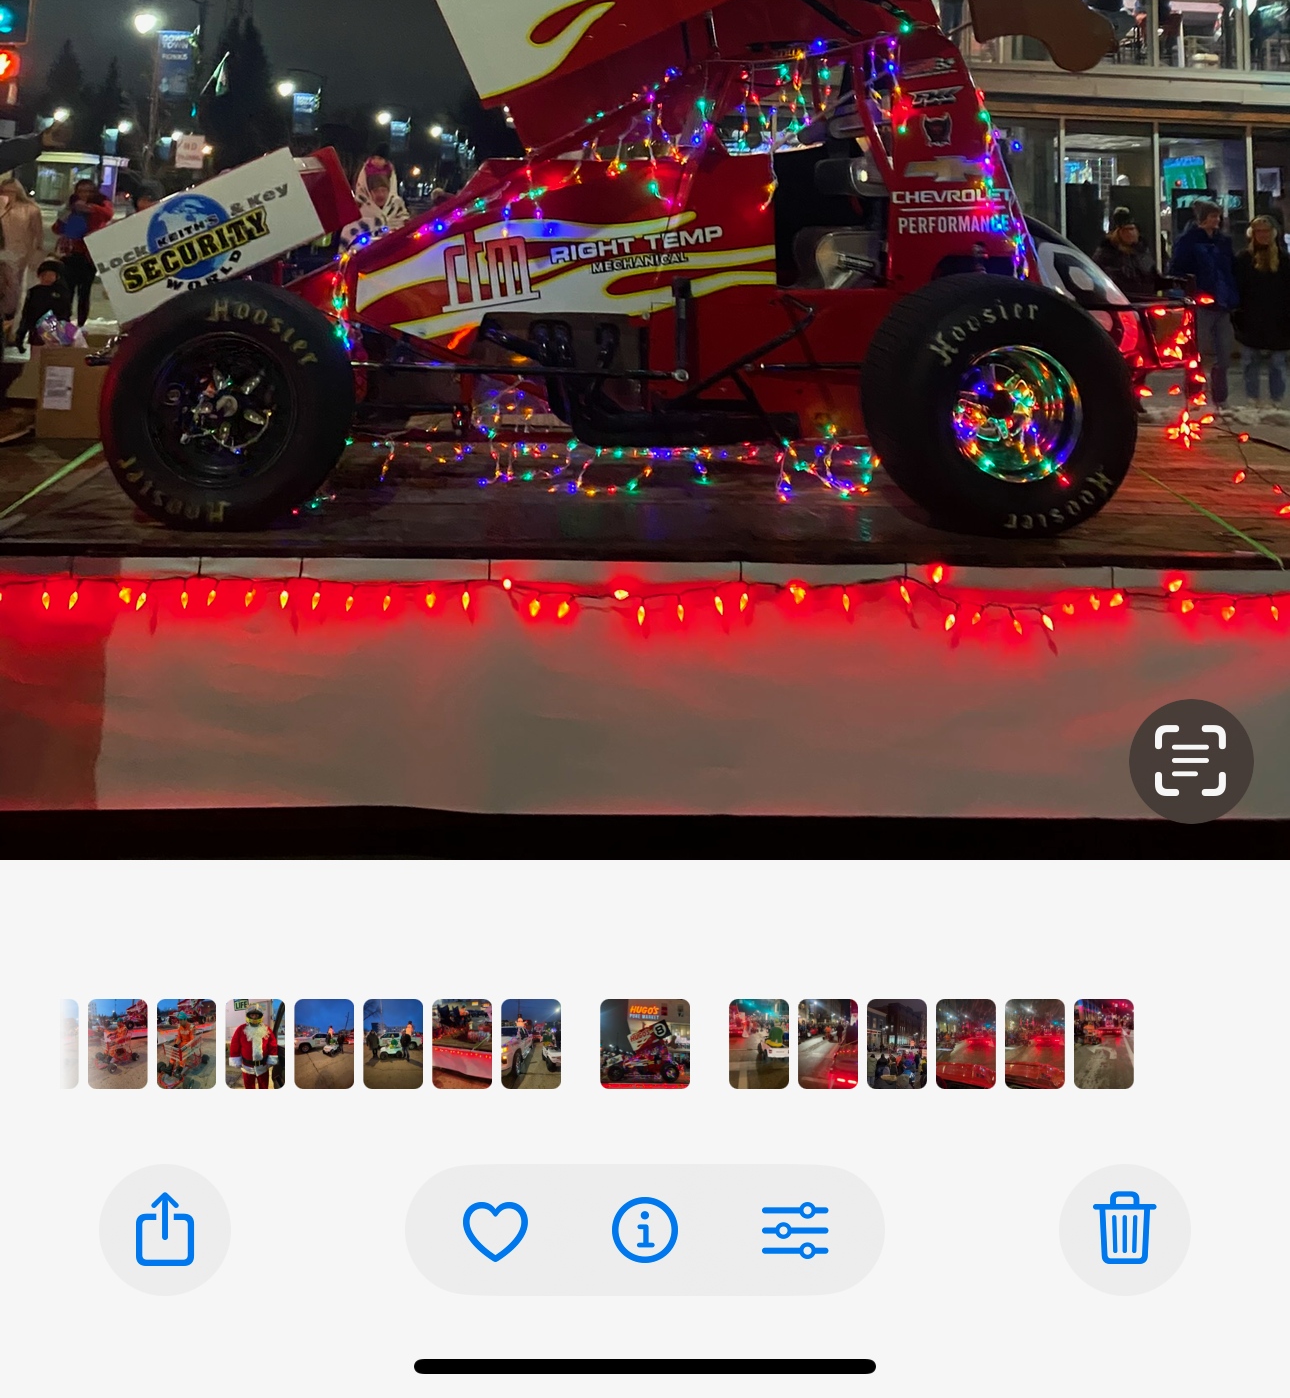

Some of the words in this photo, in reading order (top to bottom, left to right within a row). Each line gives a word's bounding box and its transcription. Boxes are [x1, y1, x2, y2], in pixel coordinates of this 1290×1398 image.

[230, 202, 246, 217] &
[892, 188, 1013, 204] CHEVROLET
[157, 214, 218, 247] KEITH'S
[898, 214, 1011, 234] PERFORMANCE
[121, 207, 269, 292] SECURITY
[550, 236, 635, 264] RIGHT
[644, 226, 723, 251] TEMP
[167, 250, 242, 290] WORLD
[592, 252, 689, 274] MECHANICAL
[928, 298, 1039, 366] Hoosier
